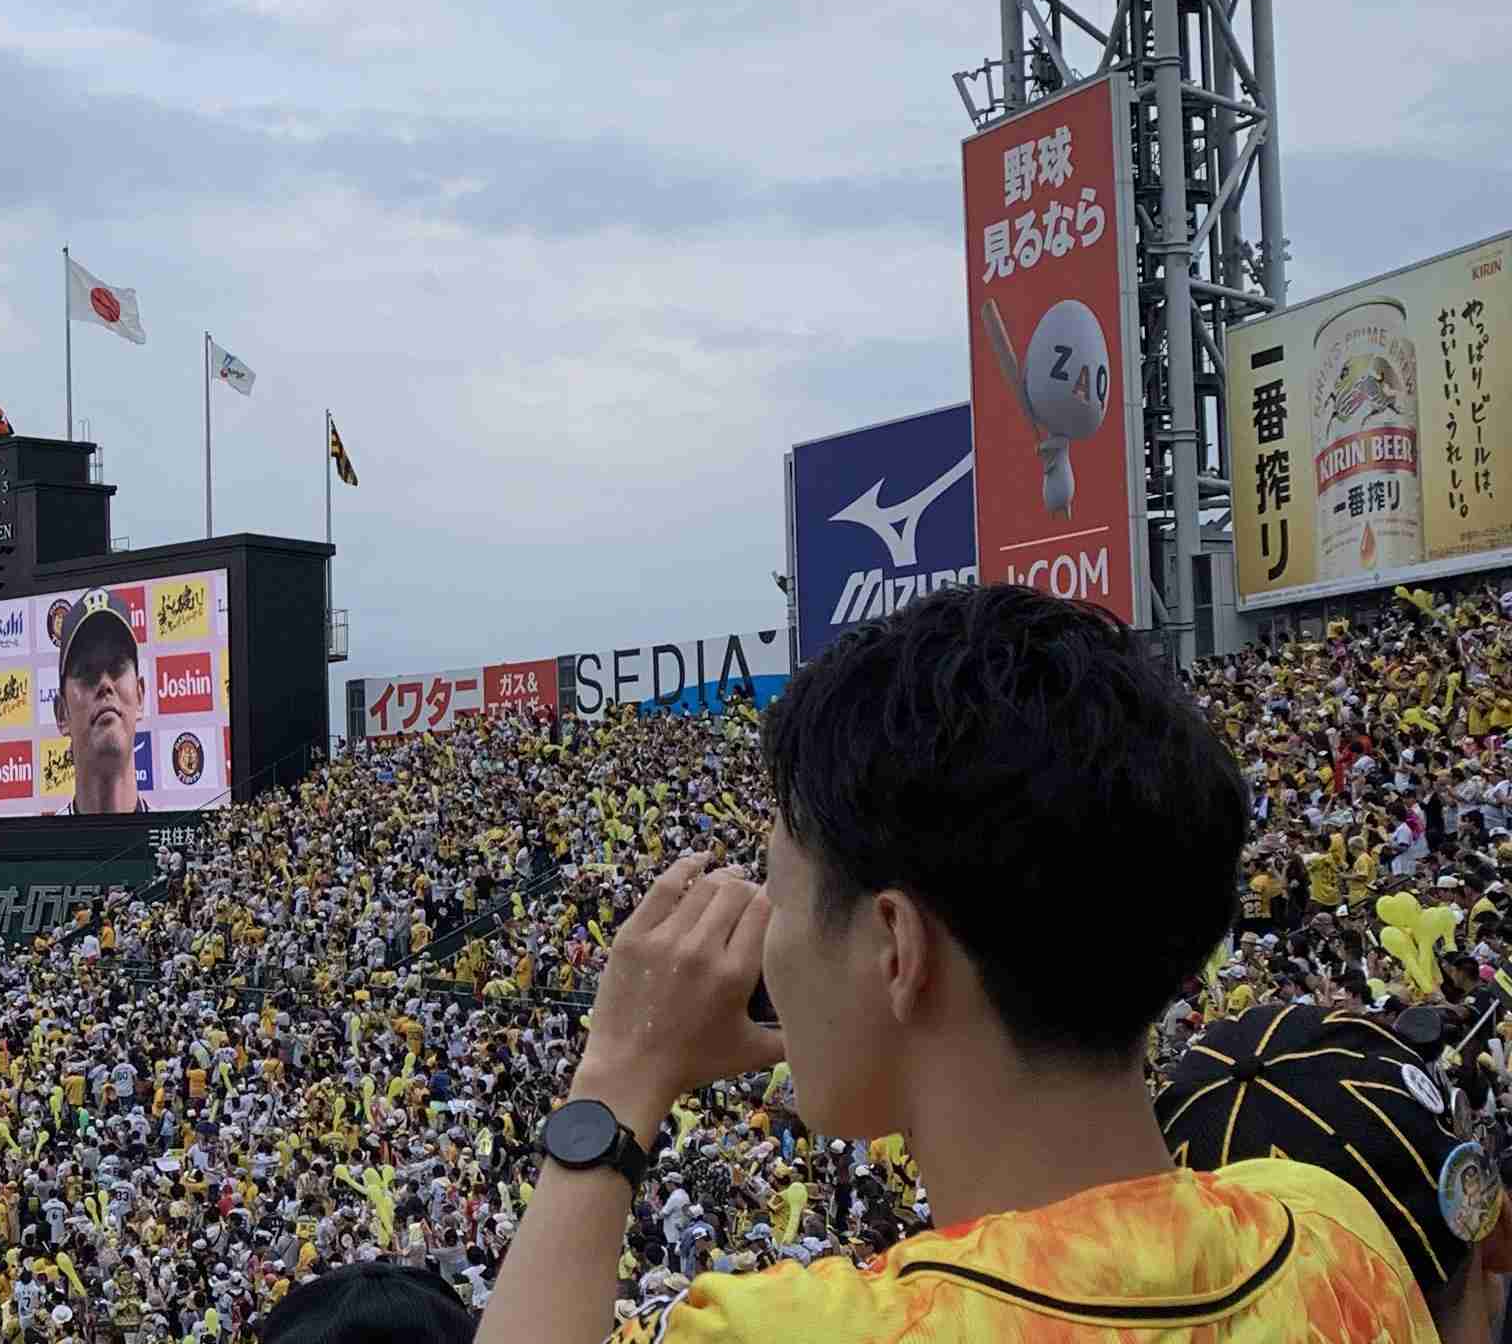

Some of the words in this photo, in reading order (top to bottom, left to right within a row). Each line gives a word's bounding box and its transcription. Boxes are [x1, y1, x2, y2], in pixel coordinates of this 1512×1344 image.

[1003, 125, 1075, 207] 野球
[982, 187, 1106, 284] 見るなら
[1472, 258, 1502, 281] KIRIN
[1250, 345, 1290, 581] 一番搾り
[1320, 443, 1367, 482] KIRIN
[1371, 434, 1415, 462] BEER
[1332, 479, 1401, 518] 一番搾り
[158, 667, 211, 700] Joshin
[369, 676, 483, 732] イワタニ
[499, 671, 538, 697] ガス&
